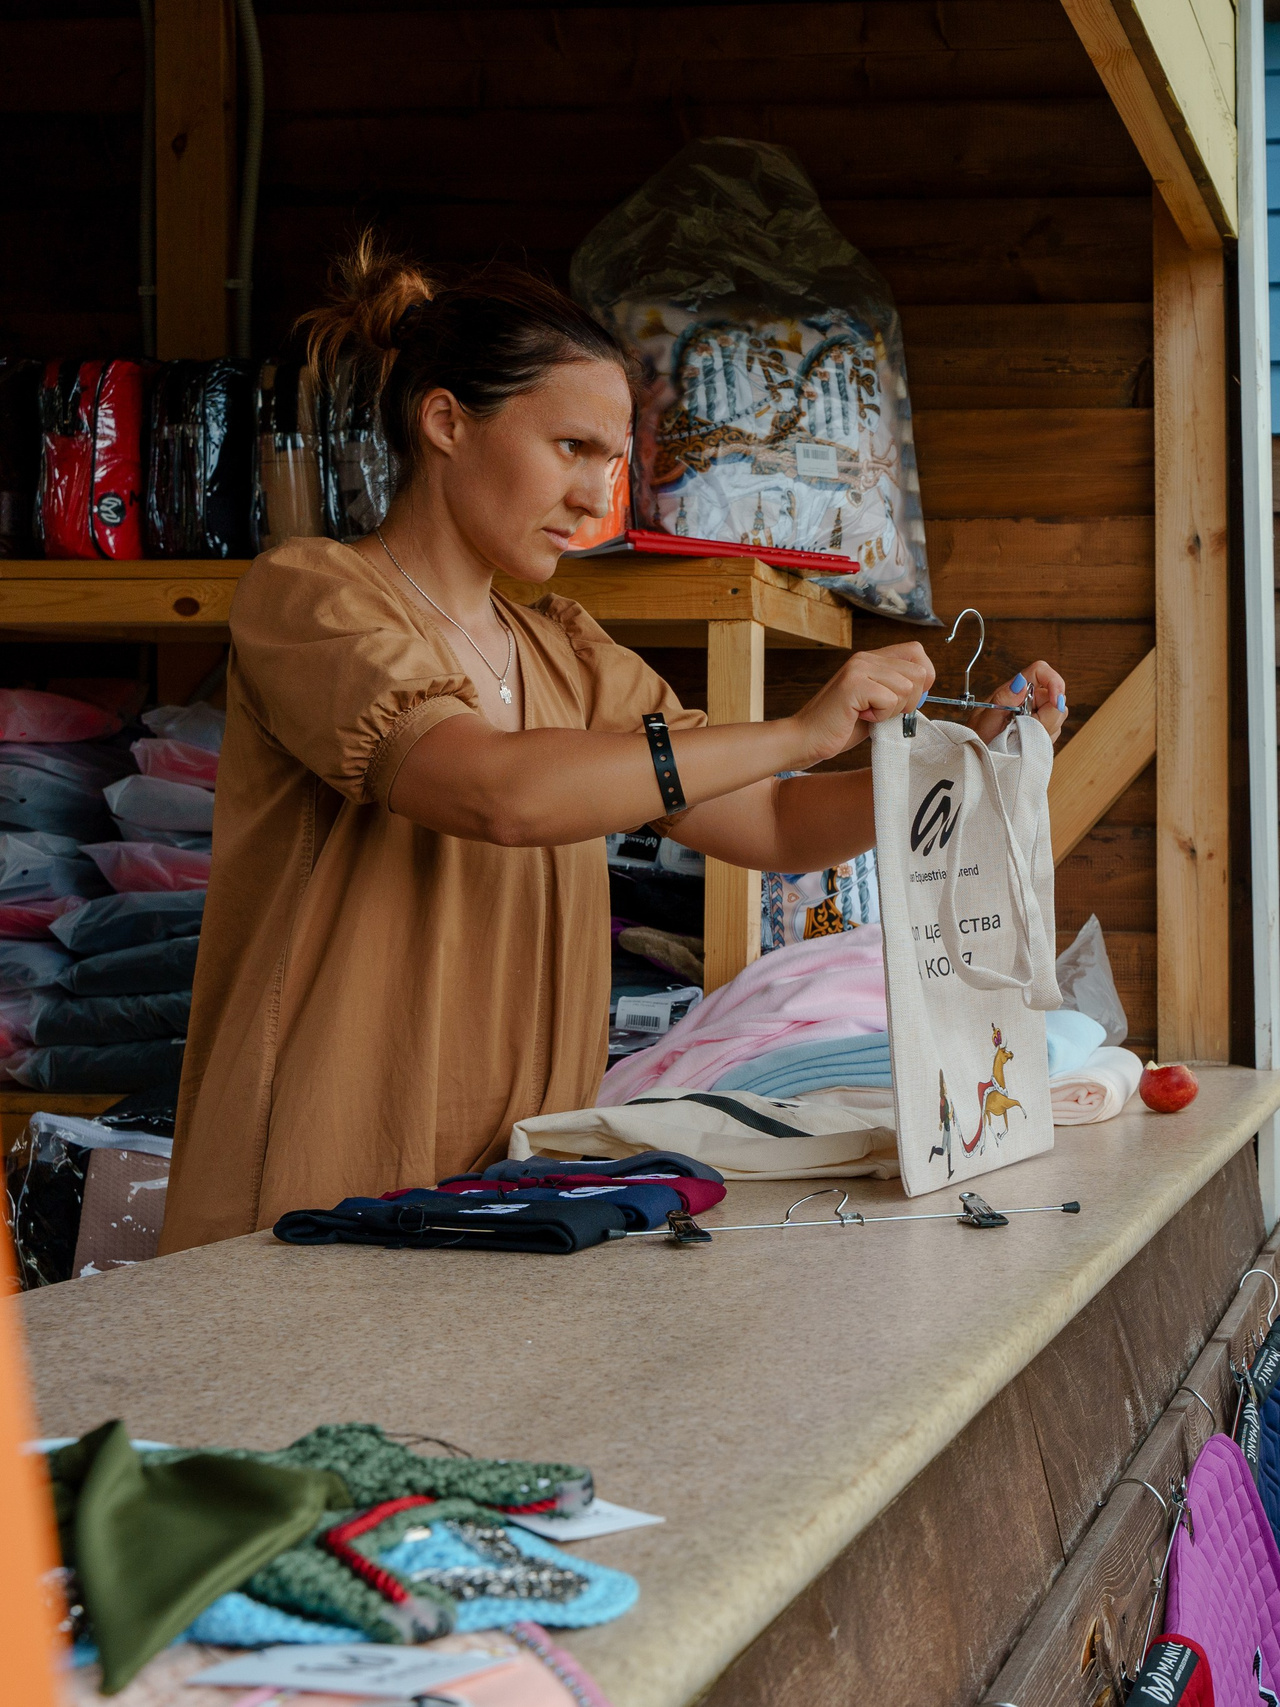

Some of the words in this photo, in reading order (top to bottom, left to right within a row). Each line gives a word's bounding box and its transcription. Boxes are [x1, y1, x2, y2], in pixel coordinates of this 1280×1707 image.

[914, 868, 949, 884] Equestria
[957, 863, 980, 878] rend
[924, 913, 1002, 944] цаства
